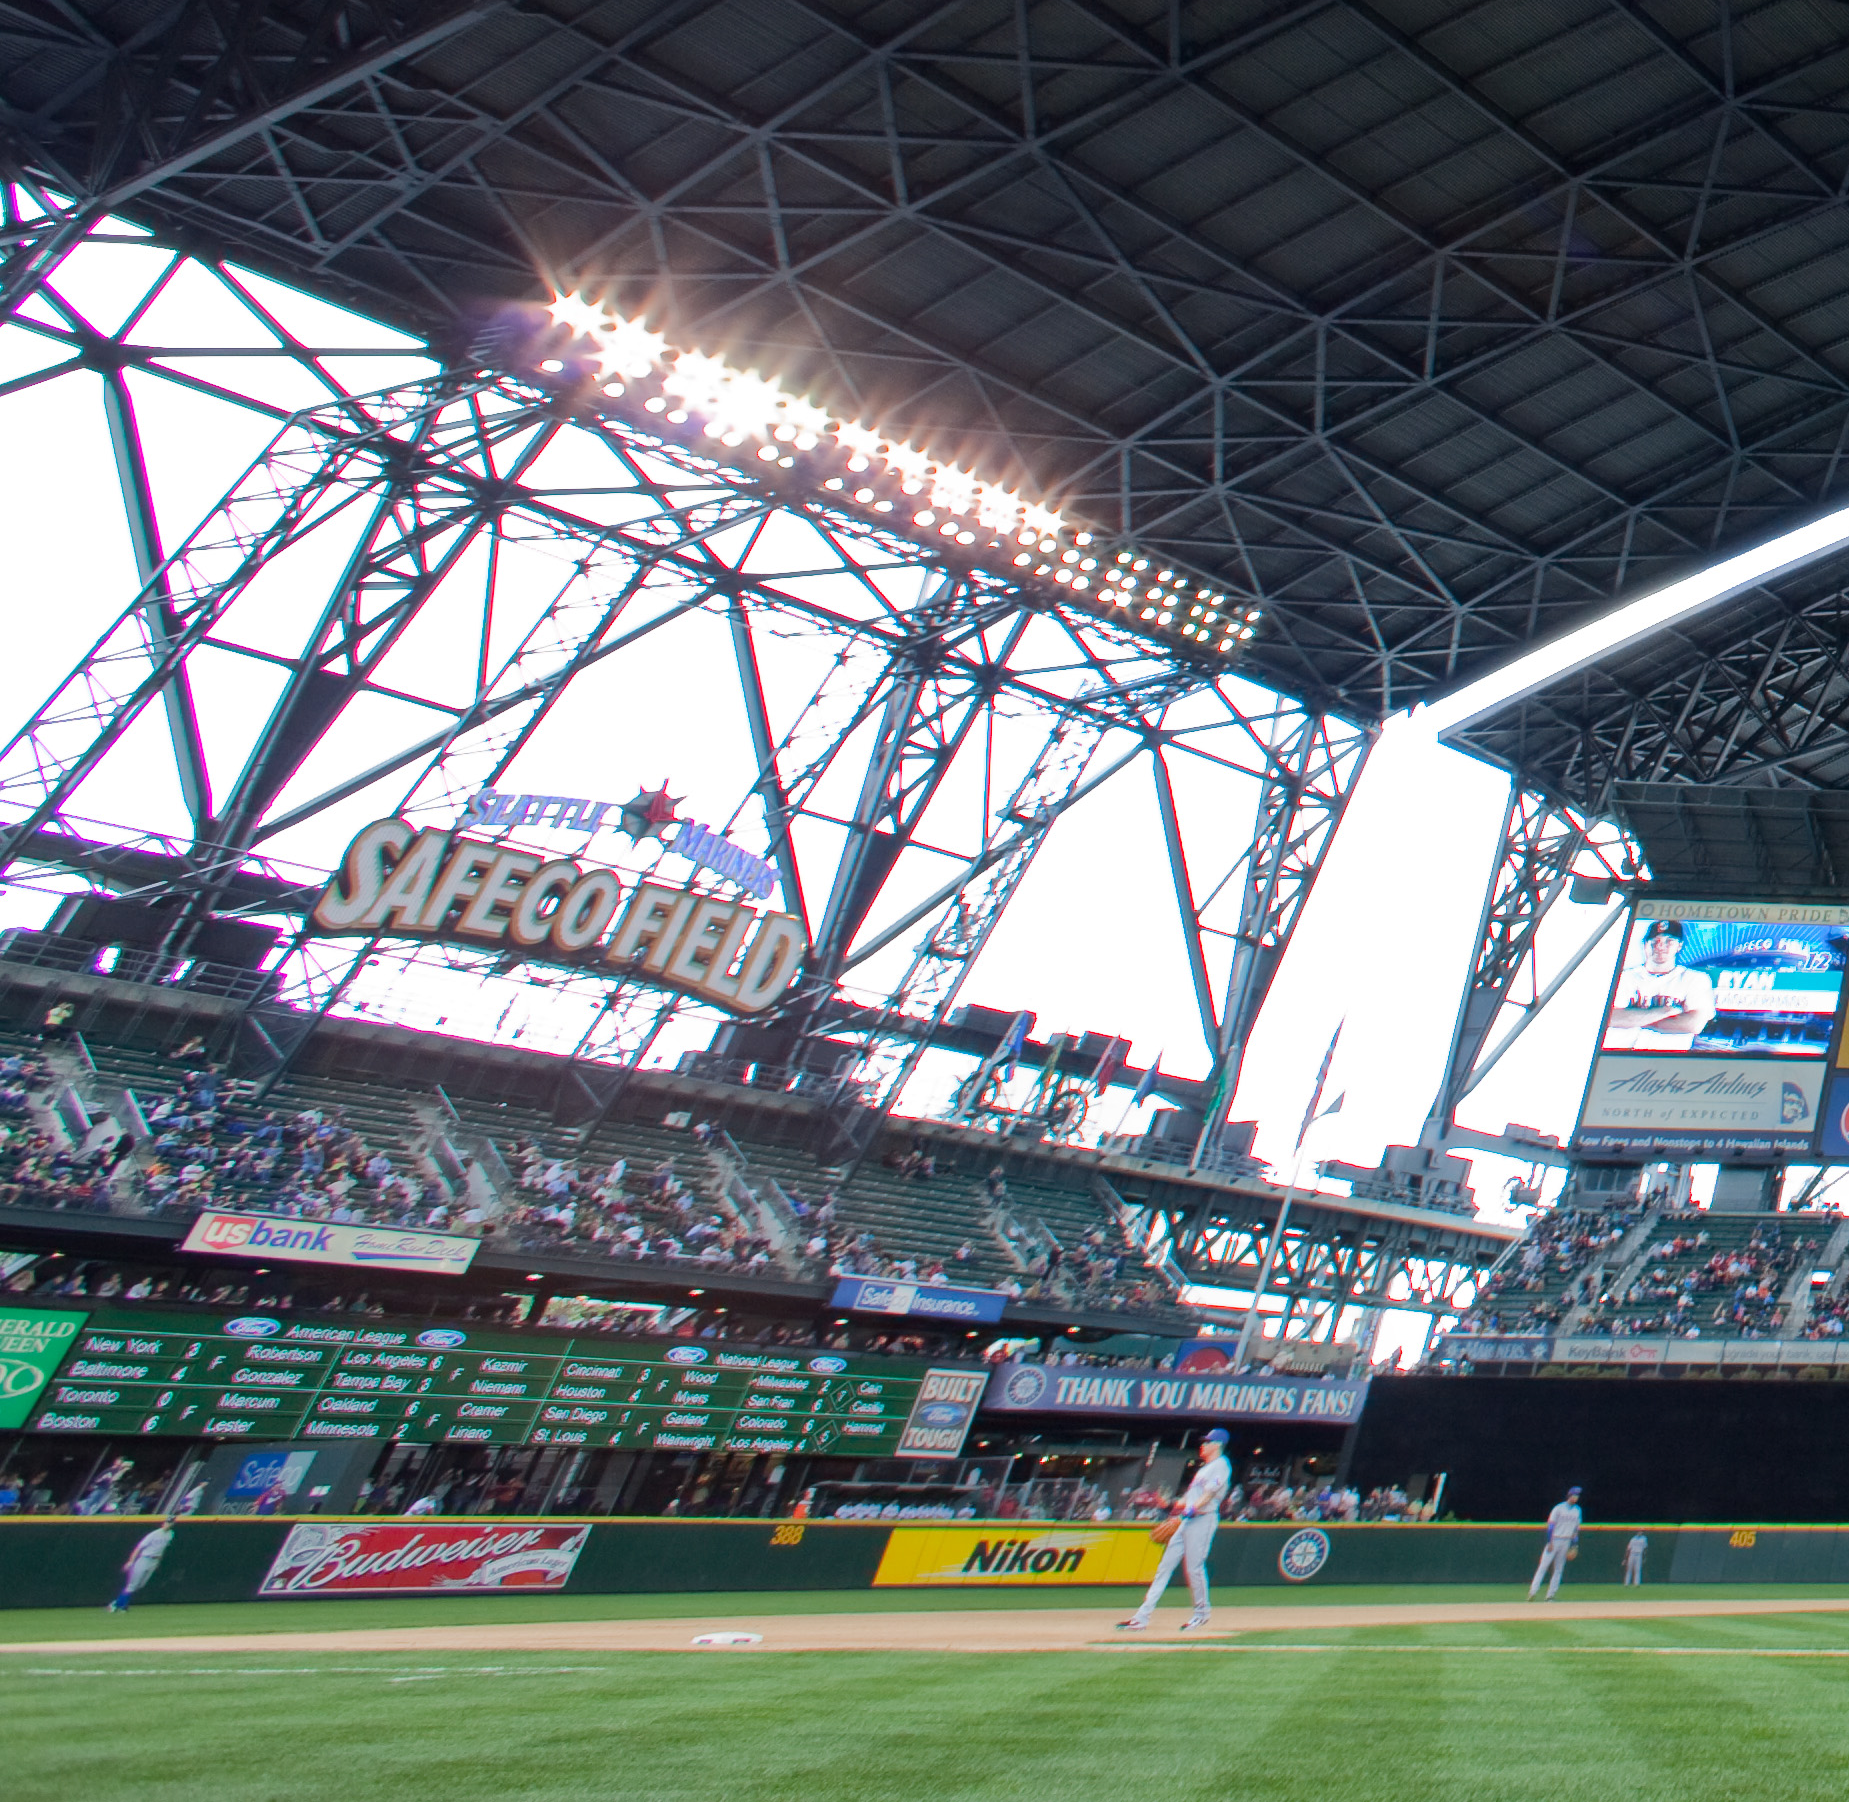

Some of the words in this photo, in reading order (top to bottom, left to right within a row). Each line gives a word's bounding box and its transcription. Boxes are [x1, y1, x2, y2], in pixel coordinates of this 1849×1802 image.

[460, 787, 611, 832] SEATTLE
[314, 818, 621, 952] SAFECO
[605, 881, 804, 1014] FIELD
[1659, 904, 1770, 919] HOMETOWN
[1777, 908, 1833, 922] PRIDE
[1718, 970, 1776, 990] RYAN
[1608, 1069, 1687, 1096] Alaska
[1684, 1071, 1769, 1099] Airlines
[1602, 1108, 1652, 1118] NORTH
[1660, 1109, 1672, 1120] of
[1681, 1110, 1759, 1120] EXPECTED
[1579, 1136, 1601, 1145] Low
[1602, 1136, 1629, 1147] Fares
[1632, 1137, 1651, 1147] and
[1654, 1137, 1701, 1150] Nonstops
[1704, 1139, 1714, 1148] to
[1716, 1139, 1724, 1148] 4
[1726, 1139, 1771, 1149] Hawaiian
[1774, 1140, 1809, 1150] Islands
[860, 1286, 912, 1306] Safeco
[0, 1318, 76, 1338] ERALD
[285, 1324, 355, 1341] American
[351, 1329, 407, 1346] League
[85, 1336, 125, 1352] New
[126, 1339, 163, 1354] York
[246, 1344, 323, 1362] Robertson
[1568, 1345, 1626, 1361] KeyBank
[69, 1360, 149, 1378] Baltimore
[341, 1350, 372, 1365] Los
[372, 1352, 428, 1370] Angeles
[715, 1353, 762, 1368] National
[760, 1356, 800, 1372] League
[232, 1368, 304, 1386] Gonzalez
[333, 1372, 379, 1390] Tampa
[380, 1375, 412, 1391] Bay
[682, 1370, 720, 1385] Wood
[56, 1386, 120, 1404] Toronto
[553, 1384, 607, 1399] Houston
[921, 1375, 982, 1402] BUILT
[1055, 1375, 1134, 1407] THANK
[1138, 1380, 1189, 1410] YOU
[1187, 1383, 1298, 1415] MARINERS
[1297, 1388, 1357, 1417] FANS!
[318, 1396, 378, 1414] Oakland
[745, 1394, 771, 1408] San
[769, 1395, 796, 1410] Fran
[38, 1412, 100, 1430] Boston
[542, 1406, 571, 1421] San
[571, 1407, 608, 1425] Diego
[736, 1415, 788, 1431] Colorado
[203, 1418, 256, 1434] Lester
[303, 1420, 380, 1437] Minnesota
[554, 1429, 588, 1444] Louis
[905, 1427, 963, 1448] TOUGH
[769, 1525, 805, 1546] 388
[1729, 1531, 1757, 1547] 405
[287, 1527, 546, 1591] Budweiser
[961, 1538, 1087, 1575] Nikon
